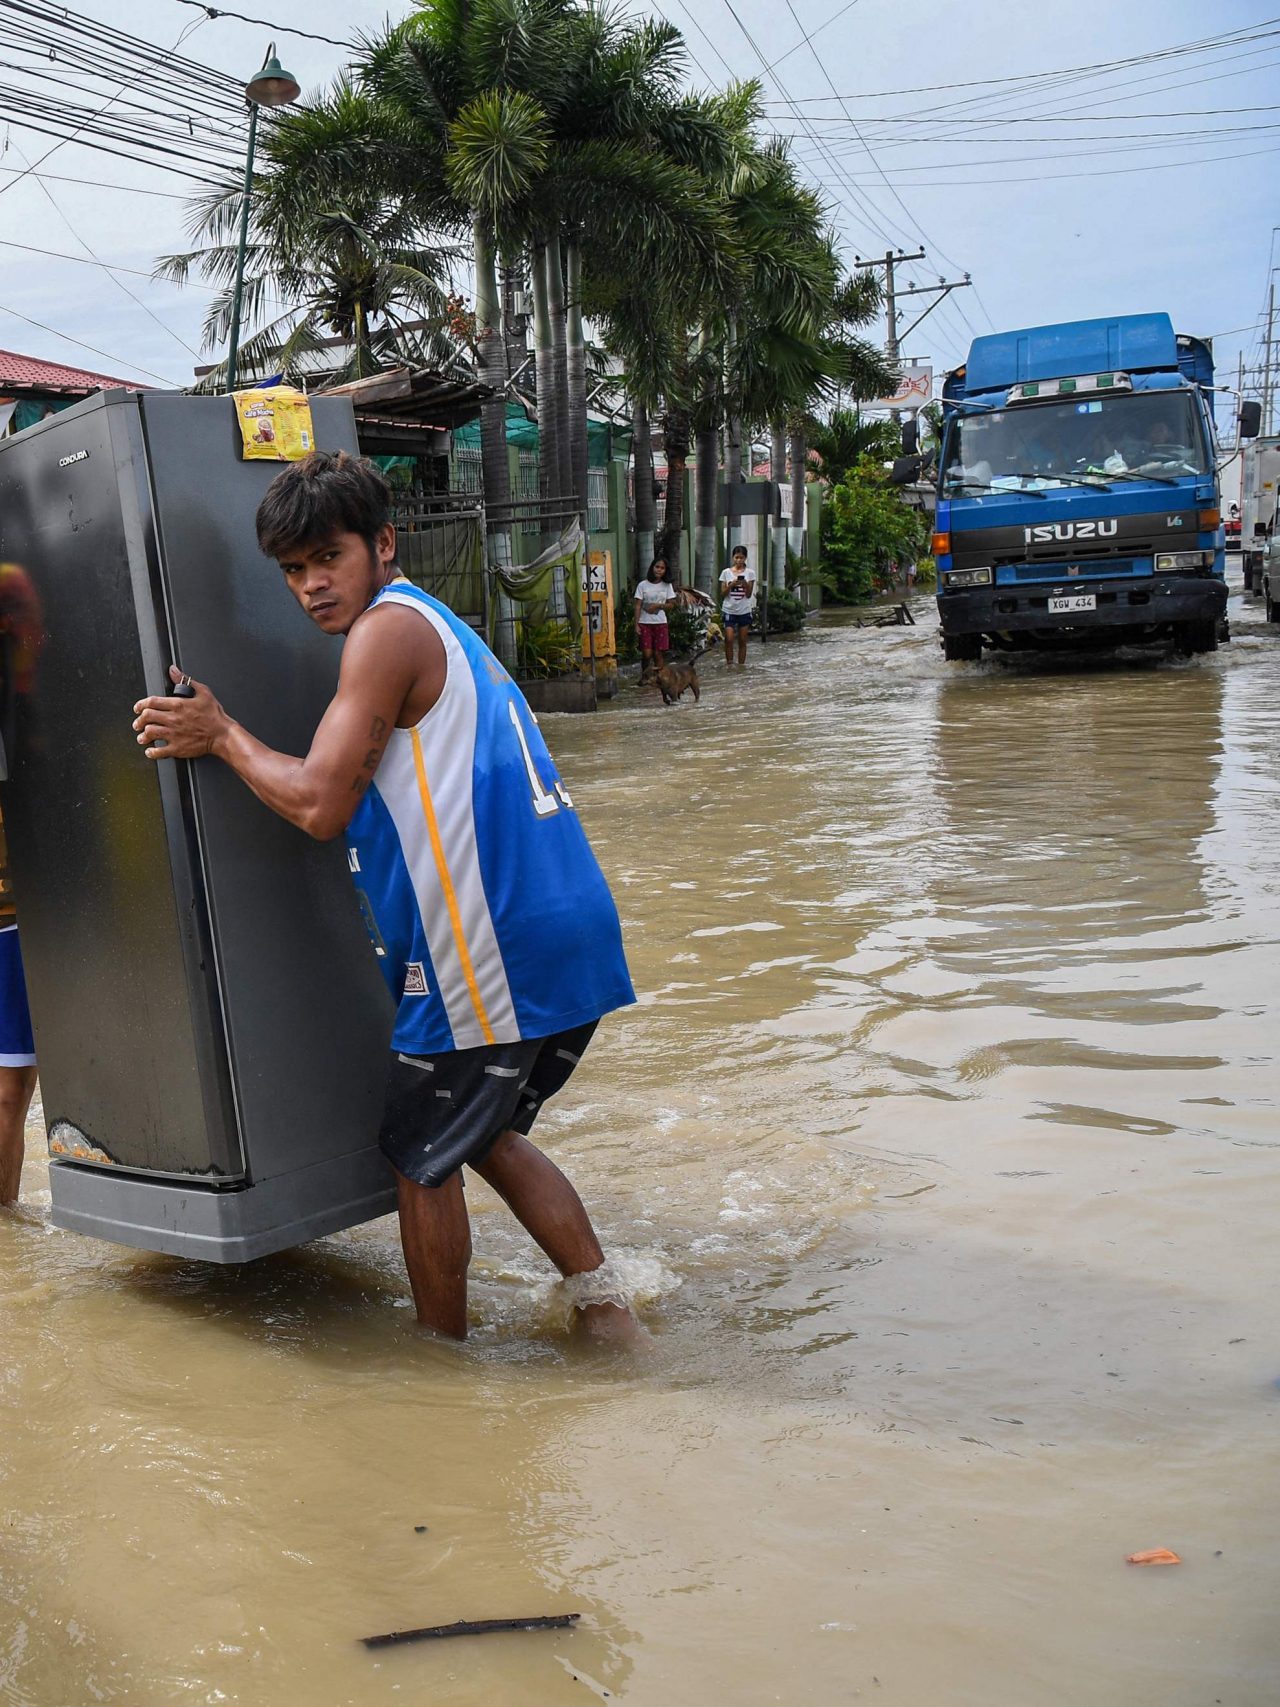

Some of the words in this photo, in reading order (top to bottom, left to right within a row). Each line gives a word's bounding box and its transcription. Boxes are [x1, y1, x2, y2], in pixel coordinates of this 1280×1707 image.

[58, 450, 89, 468] CONDURA
[1024, 518, 1118, 543] ISUZU
[589, 566, 598, 578] K
[1053, 600, 1070, 609] XGW
[1075, 597, 1092, 607] 434
